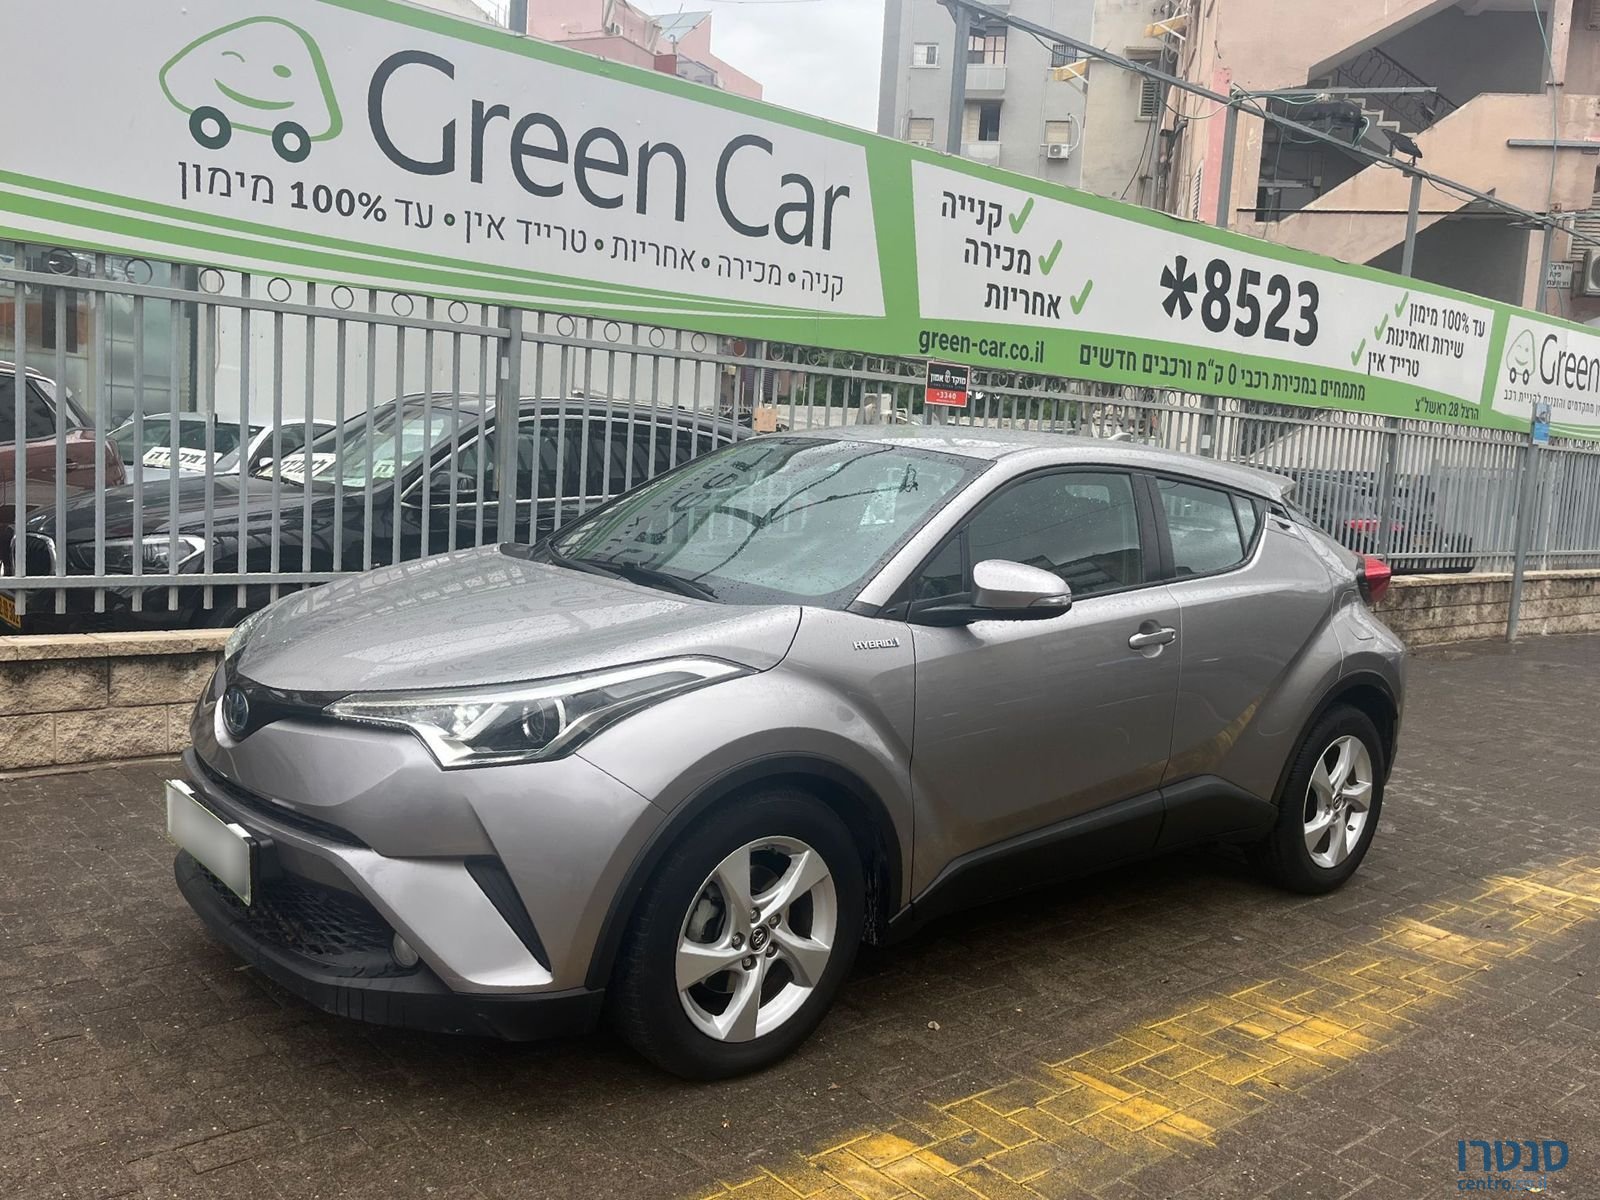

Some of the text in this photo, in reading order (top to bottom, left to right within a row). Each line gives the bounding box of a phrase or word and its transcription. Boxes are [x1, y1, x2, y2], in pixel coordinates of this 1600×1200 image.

[368, 50, 850, 250] Green Car
[941, 190, 1003, 236] קנייה
[178, 161, 843, 302] קניה מכירה אחריות טרייד אין עד 100% מימון
[964, 237, 1032, 276] מכירה
[984, 282, 1062, 320] אחריות
[1408, 303, 1486, 338] עד 100% מימון
[918, 329, 1046, 364] green-car.co.il
[1385, 326, 1464, 359] שירות ואמינות
[1079, 343, 1137, 371] חדשים
[1142, 350, 1192, 379] ורכבים
[1367, 351, 1420, 378] טרייד אין
[1540, 334, 1600, 393] Green
[951, 375, 967, 386] מוקד
[1228, 363, 1237, 386] 0
[1241, 369, 1269, 390] רכבי
[1271, 373, 1318, 396] במכירת
[1320, 379, 1366, 401] מתמחים
[1503, 389, 1517, 401] רכב
[1448, 401, 1459, 417] 28
[1461, 403, 1479, 420] הרצל
[853, 640, 893, 650] HYBRID
